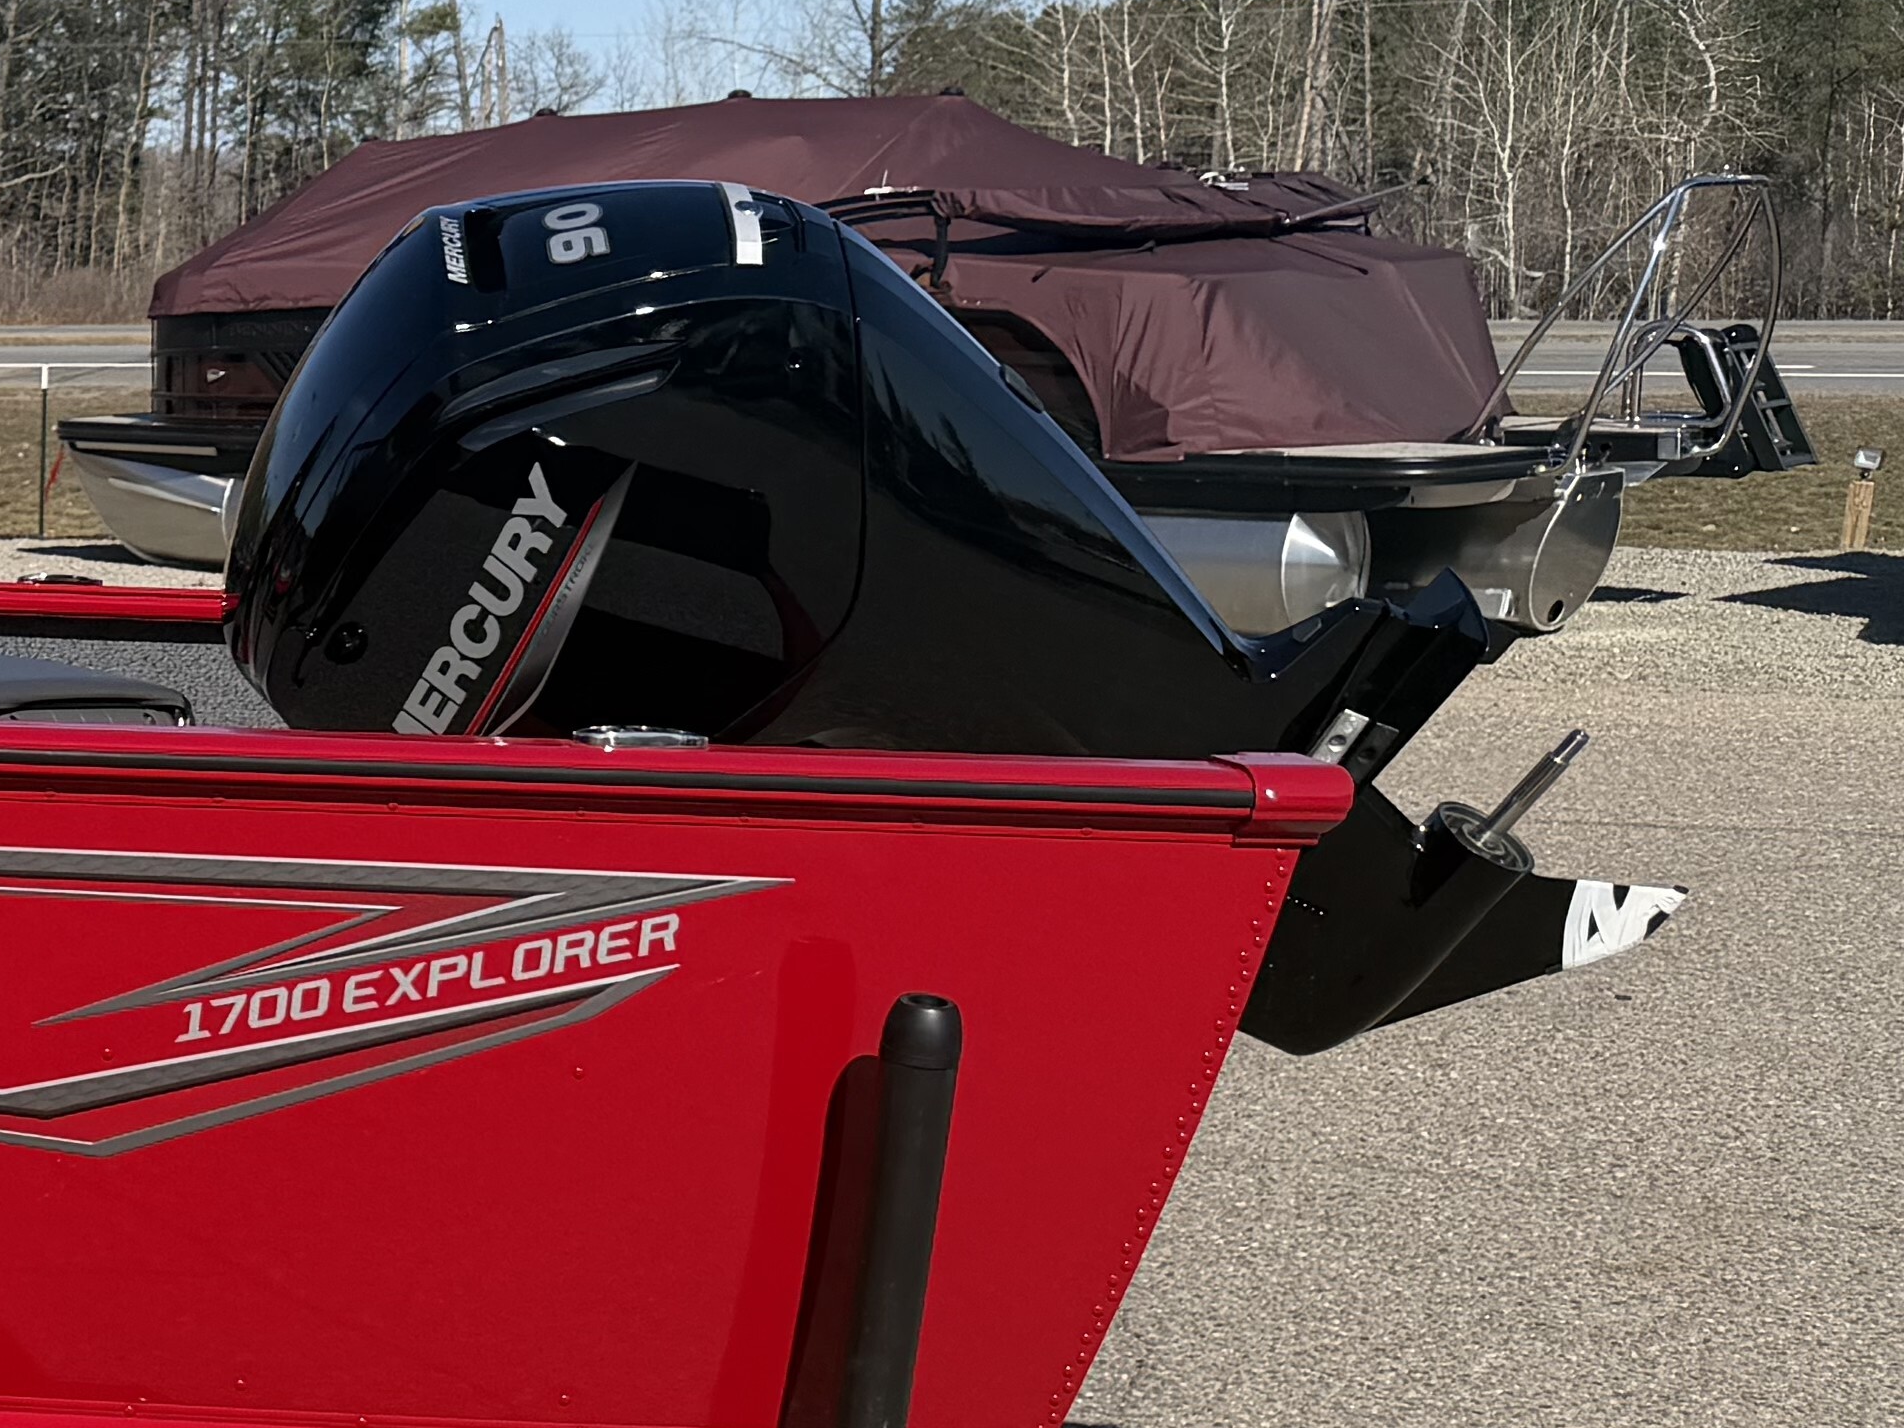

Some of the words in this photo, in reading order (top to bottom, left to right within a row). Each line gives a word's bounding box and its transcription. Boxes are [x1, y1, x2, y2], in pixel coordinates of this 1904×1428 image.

[439, 215, 469, 285] MERCURY
[544, 203, 611, 264] 90
[175, 978, 330, 1043] 1700
[342, 913, 680, 1015] EXPLORER
